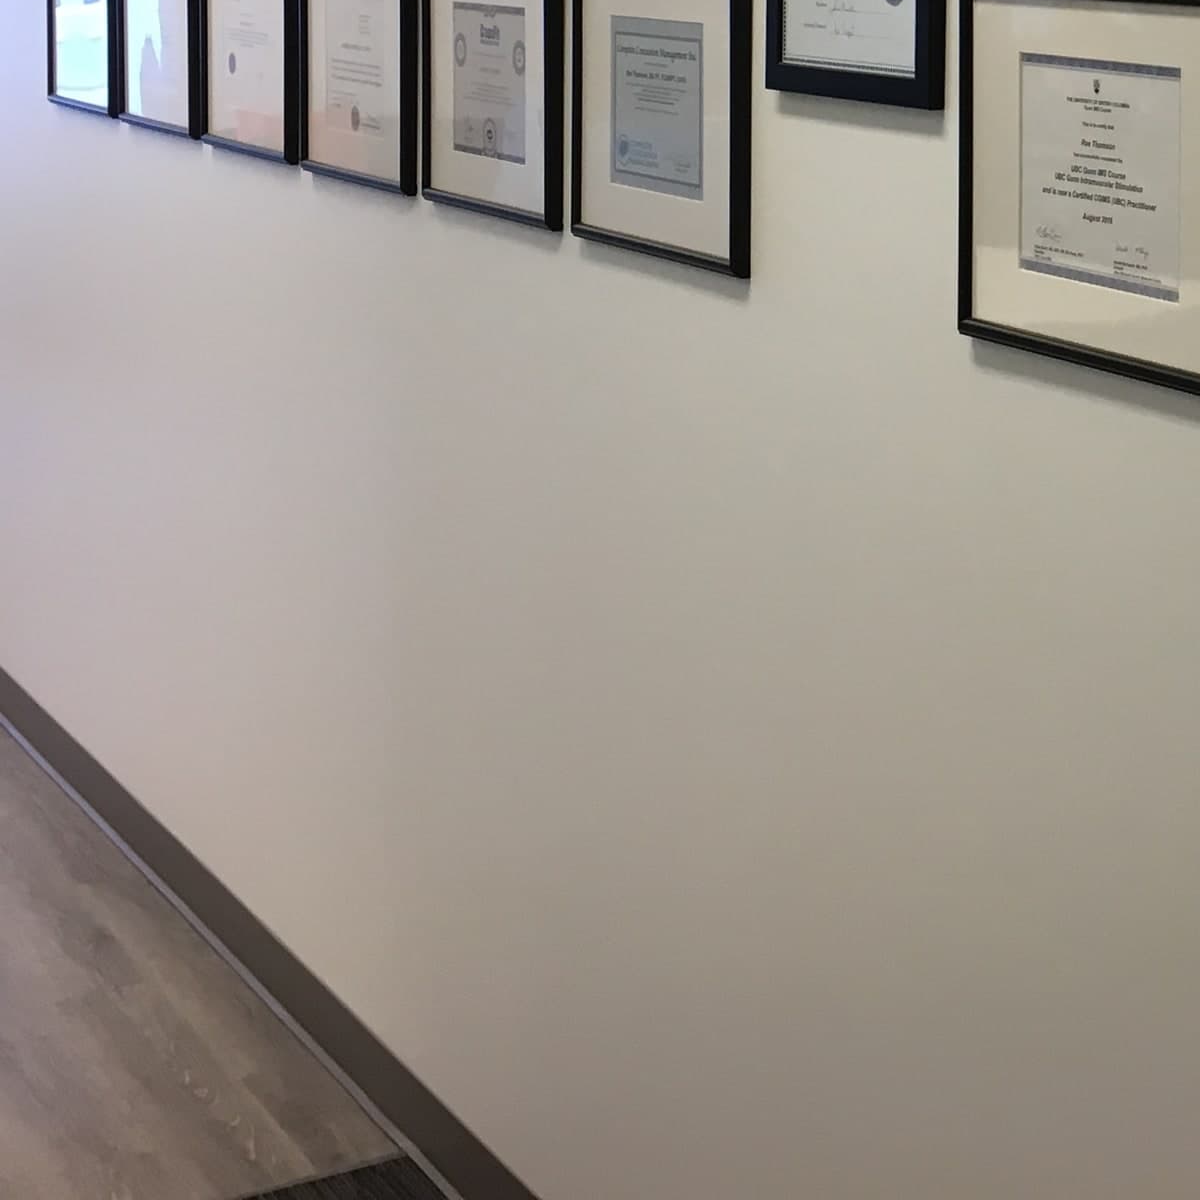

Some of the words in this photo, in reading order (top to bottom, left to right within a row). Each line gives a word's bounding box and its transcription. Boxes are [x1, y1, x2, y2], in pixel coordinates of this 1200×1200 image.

[1108, 170, 1126, 180] Course
[1072, 190, 1093, 201] Certified
[1082, 213, 1101, 223] August
